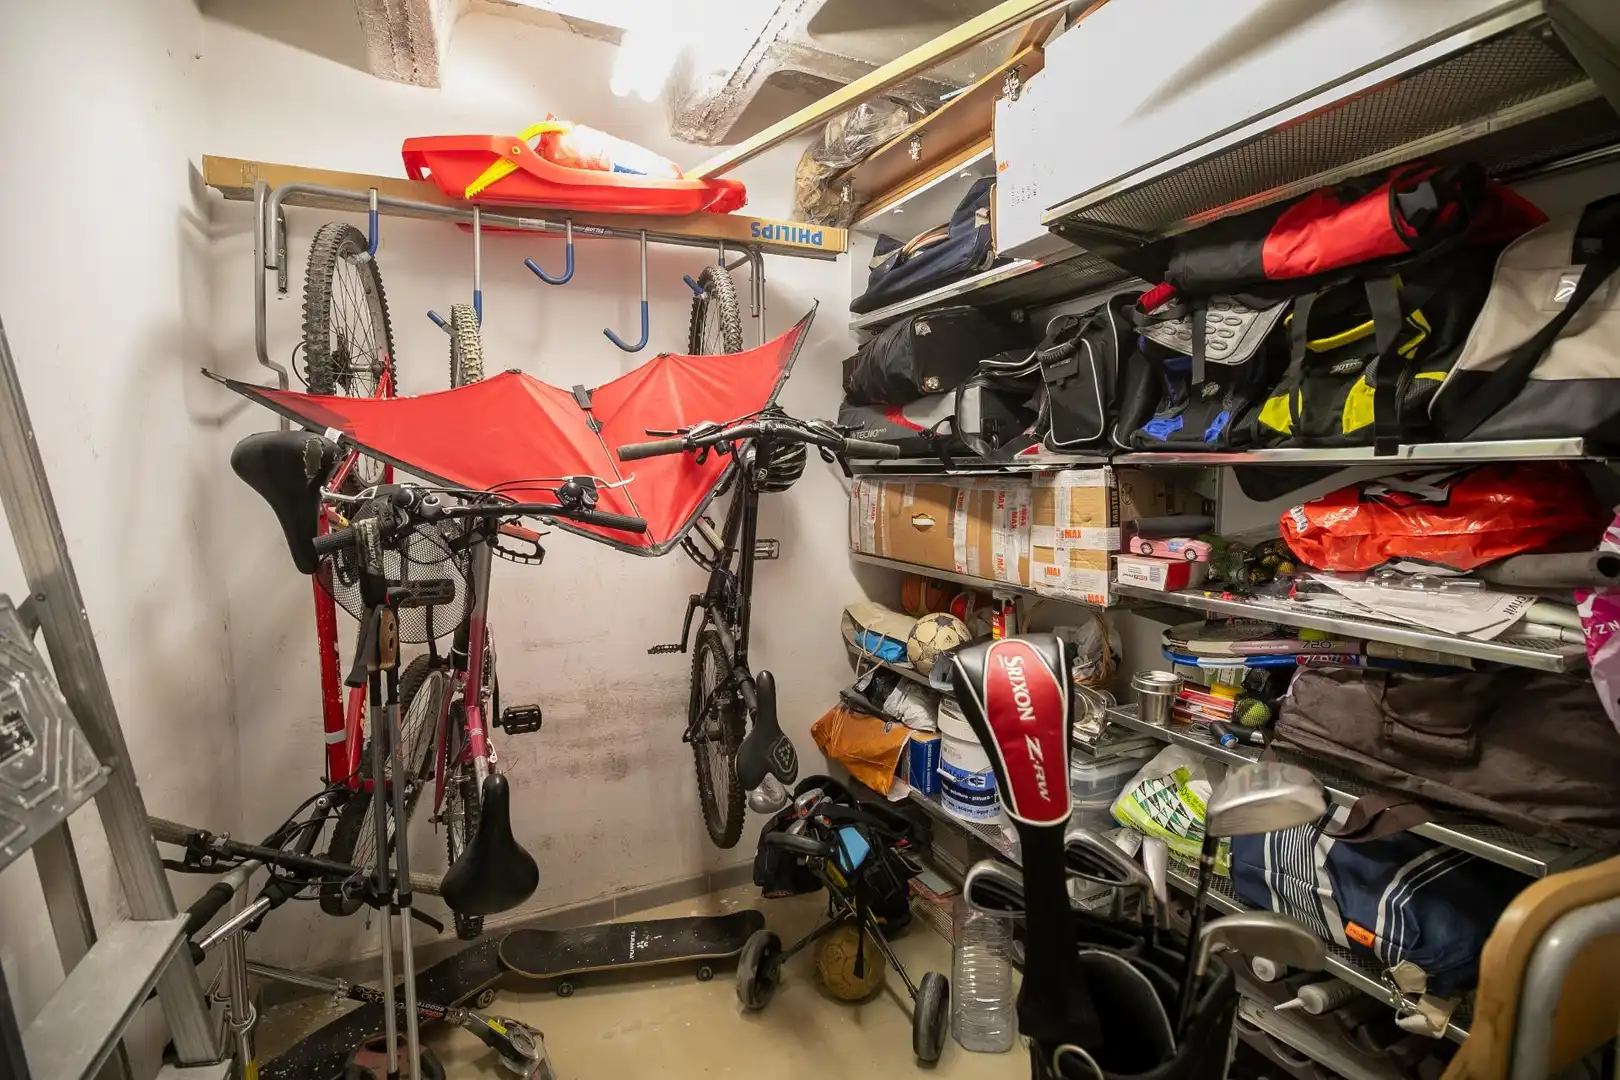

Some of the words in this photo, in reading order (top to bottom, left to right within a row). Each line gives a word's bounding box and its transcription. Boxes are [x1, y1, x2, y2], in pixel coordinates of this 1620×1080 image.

[750, 222, 823, 246] PHILIPS
[1111, 490, 1119, 522] MASTER
[1064, 529, 1082, 539] MAX
[1087, 593, 1105, 605] MAX
[1503, 596, 1527, 615] crivit
[1302, 640, 1332, 648] 720
[1000, 655, 1036, 720] SRIXON
